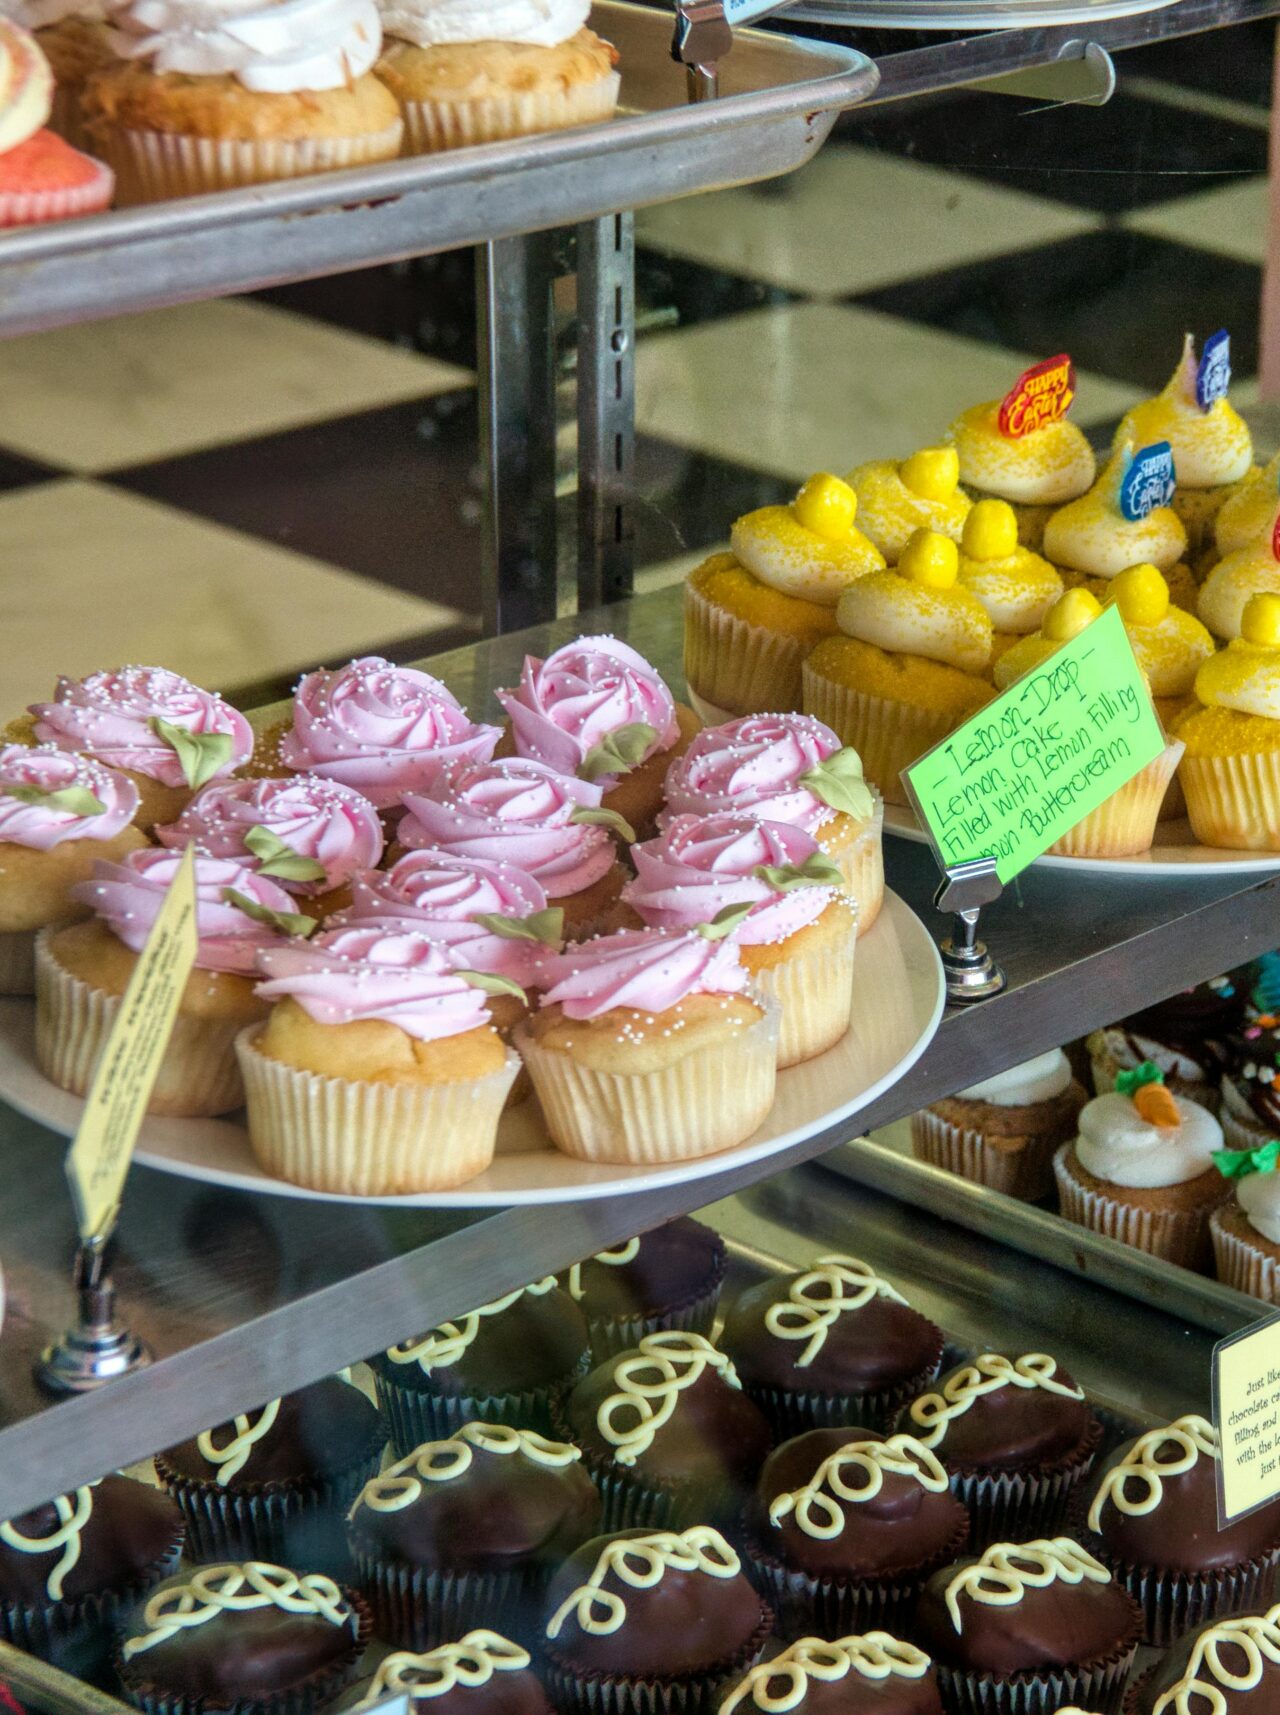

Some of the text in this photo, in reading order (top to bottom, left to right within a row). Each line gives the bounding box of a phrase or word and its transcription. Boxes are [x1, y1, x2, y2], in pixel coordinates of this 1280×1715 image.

[1024, 361, 1071, 396] HAPPY
[945, 658, 1086, 776] Lemon Drop
[933, 722, 1063, 828] Lemon Cake
[943, 684, 1140, 858] Filled with Lemon Filling
[1020, 737, 1131, 837] Buttercream
[1246, 1377, 1264, 1396] Just
[1228, 1399, 1268, 1425] chocolate
[1235, 1424, 1260, 1445] filling
[1263, 1411, 1276, 1430] and
[1237, 1446, 1256, 1465] with
[1259, 1440, 1272, 1454] the
[1261, 1459, 1275, 1479] just
